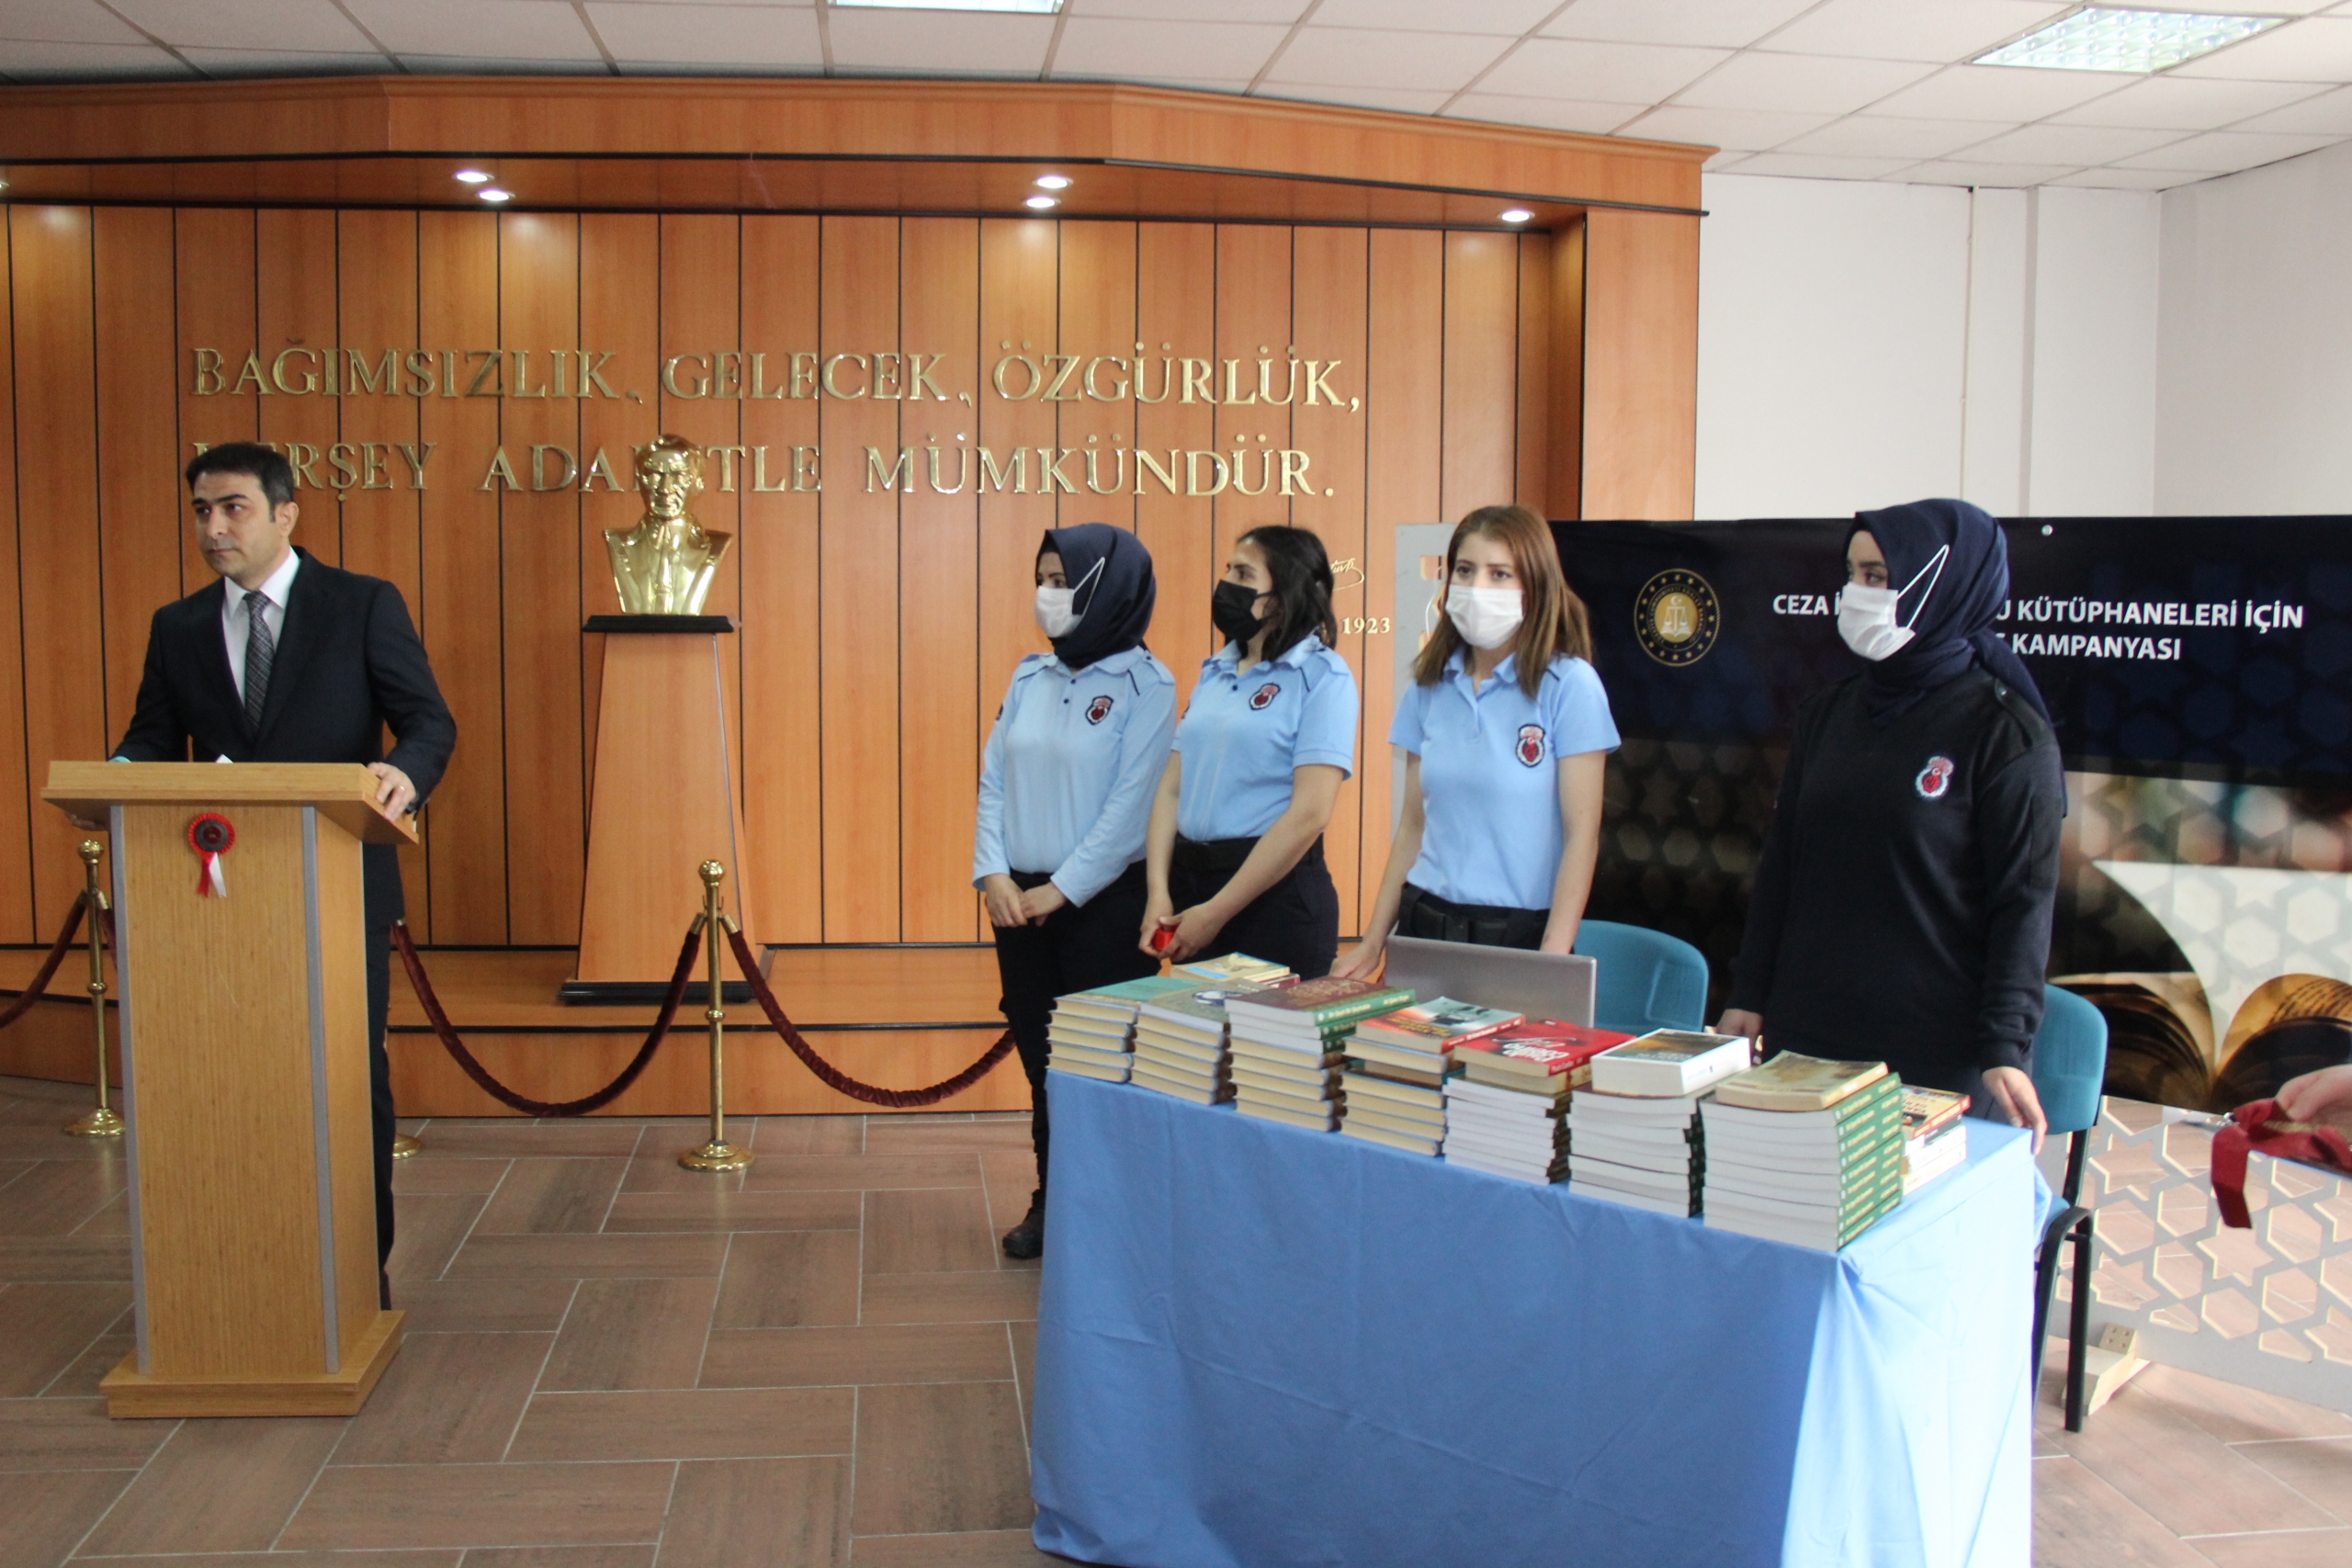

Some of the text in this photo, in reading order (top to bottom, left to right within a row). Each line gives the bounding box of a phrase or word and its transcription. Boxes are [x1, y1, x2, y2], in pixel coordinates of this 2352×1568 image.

[662, 351, 972, 408] GELECEK,
[992, 341, 1361, 413] ÖZGÜRLÜK,
[192, 432, 1335, 502] RŞEY ADATLE MÜMKÜNDÜR.
[1341, 616, 1391, 635] 1923
[1772, 594, 1829, 615] CEZA
[2018, 595, 2238, 627] KÜTÜPHANELERİ
[2245, 599, 2304, 634] İÇİN
[2012, 633, 2182, 660] KAMPANYASI
